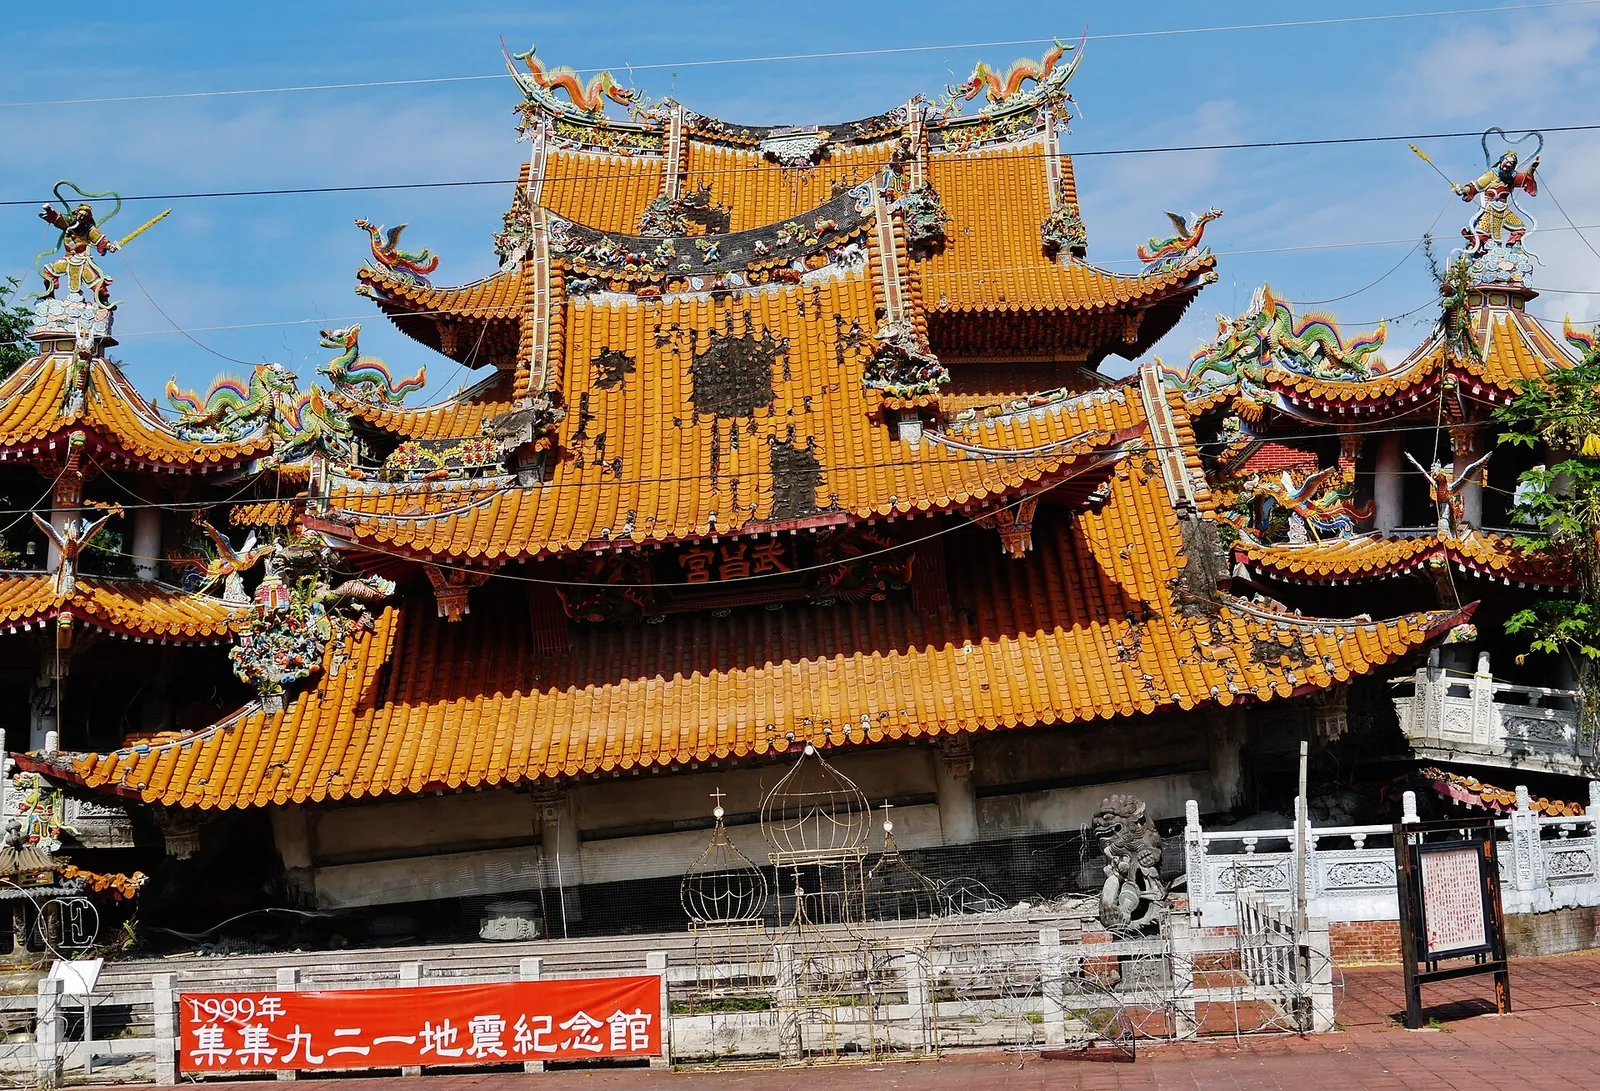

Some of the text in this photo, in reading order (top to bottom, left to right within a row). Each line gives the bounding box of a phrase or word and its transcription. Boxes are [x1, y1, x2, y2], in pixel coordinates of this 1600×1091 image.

[189, 995, 287, 1024] 1999年
[188, 1008, 653, 1067] 集集九二一地震紀念館
